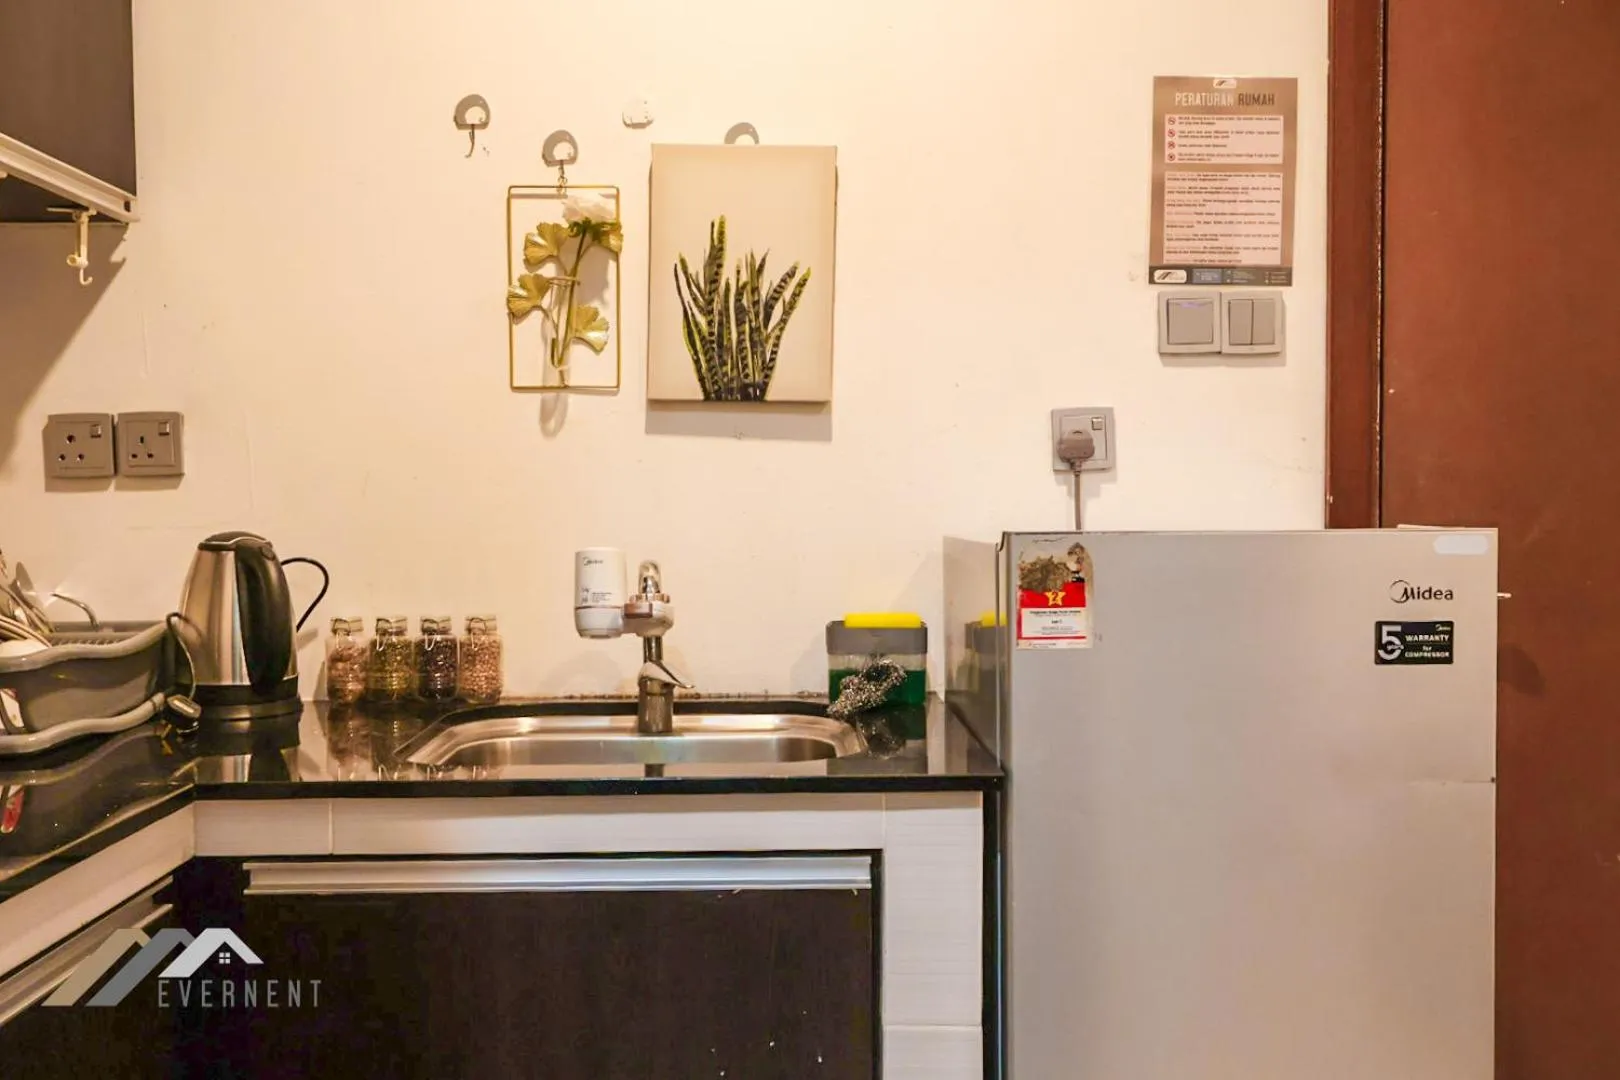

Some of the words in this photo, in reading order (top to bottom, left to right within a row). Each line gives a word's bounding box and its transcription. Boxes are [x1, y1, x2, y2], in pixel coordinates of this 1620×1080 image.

[1175, 92, 1234, 106] PERATURAN
[1237, 92, 1275, 106] RUMAH
[1389, 579, 1454, 604] Midea
[1378, 624, 1402, 660] 5
[1404, 634, 1450, 642] WARRANTY
